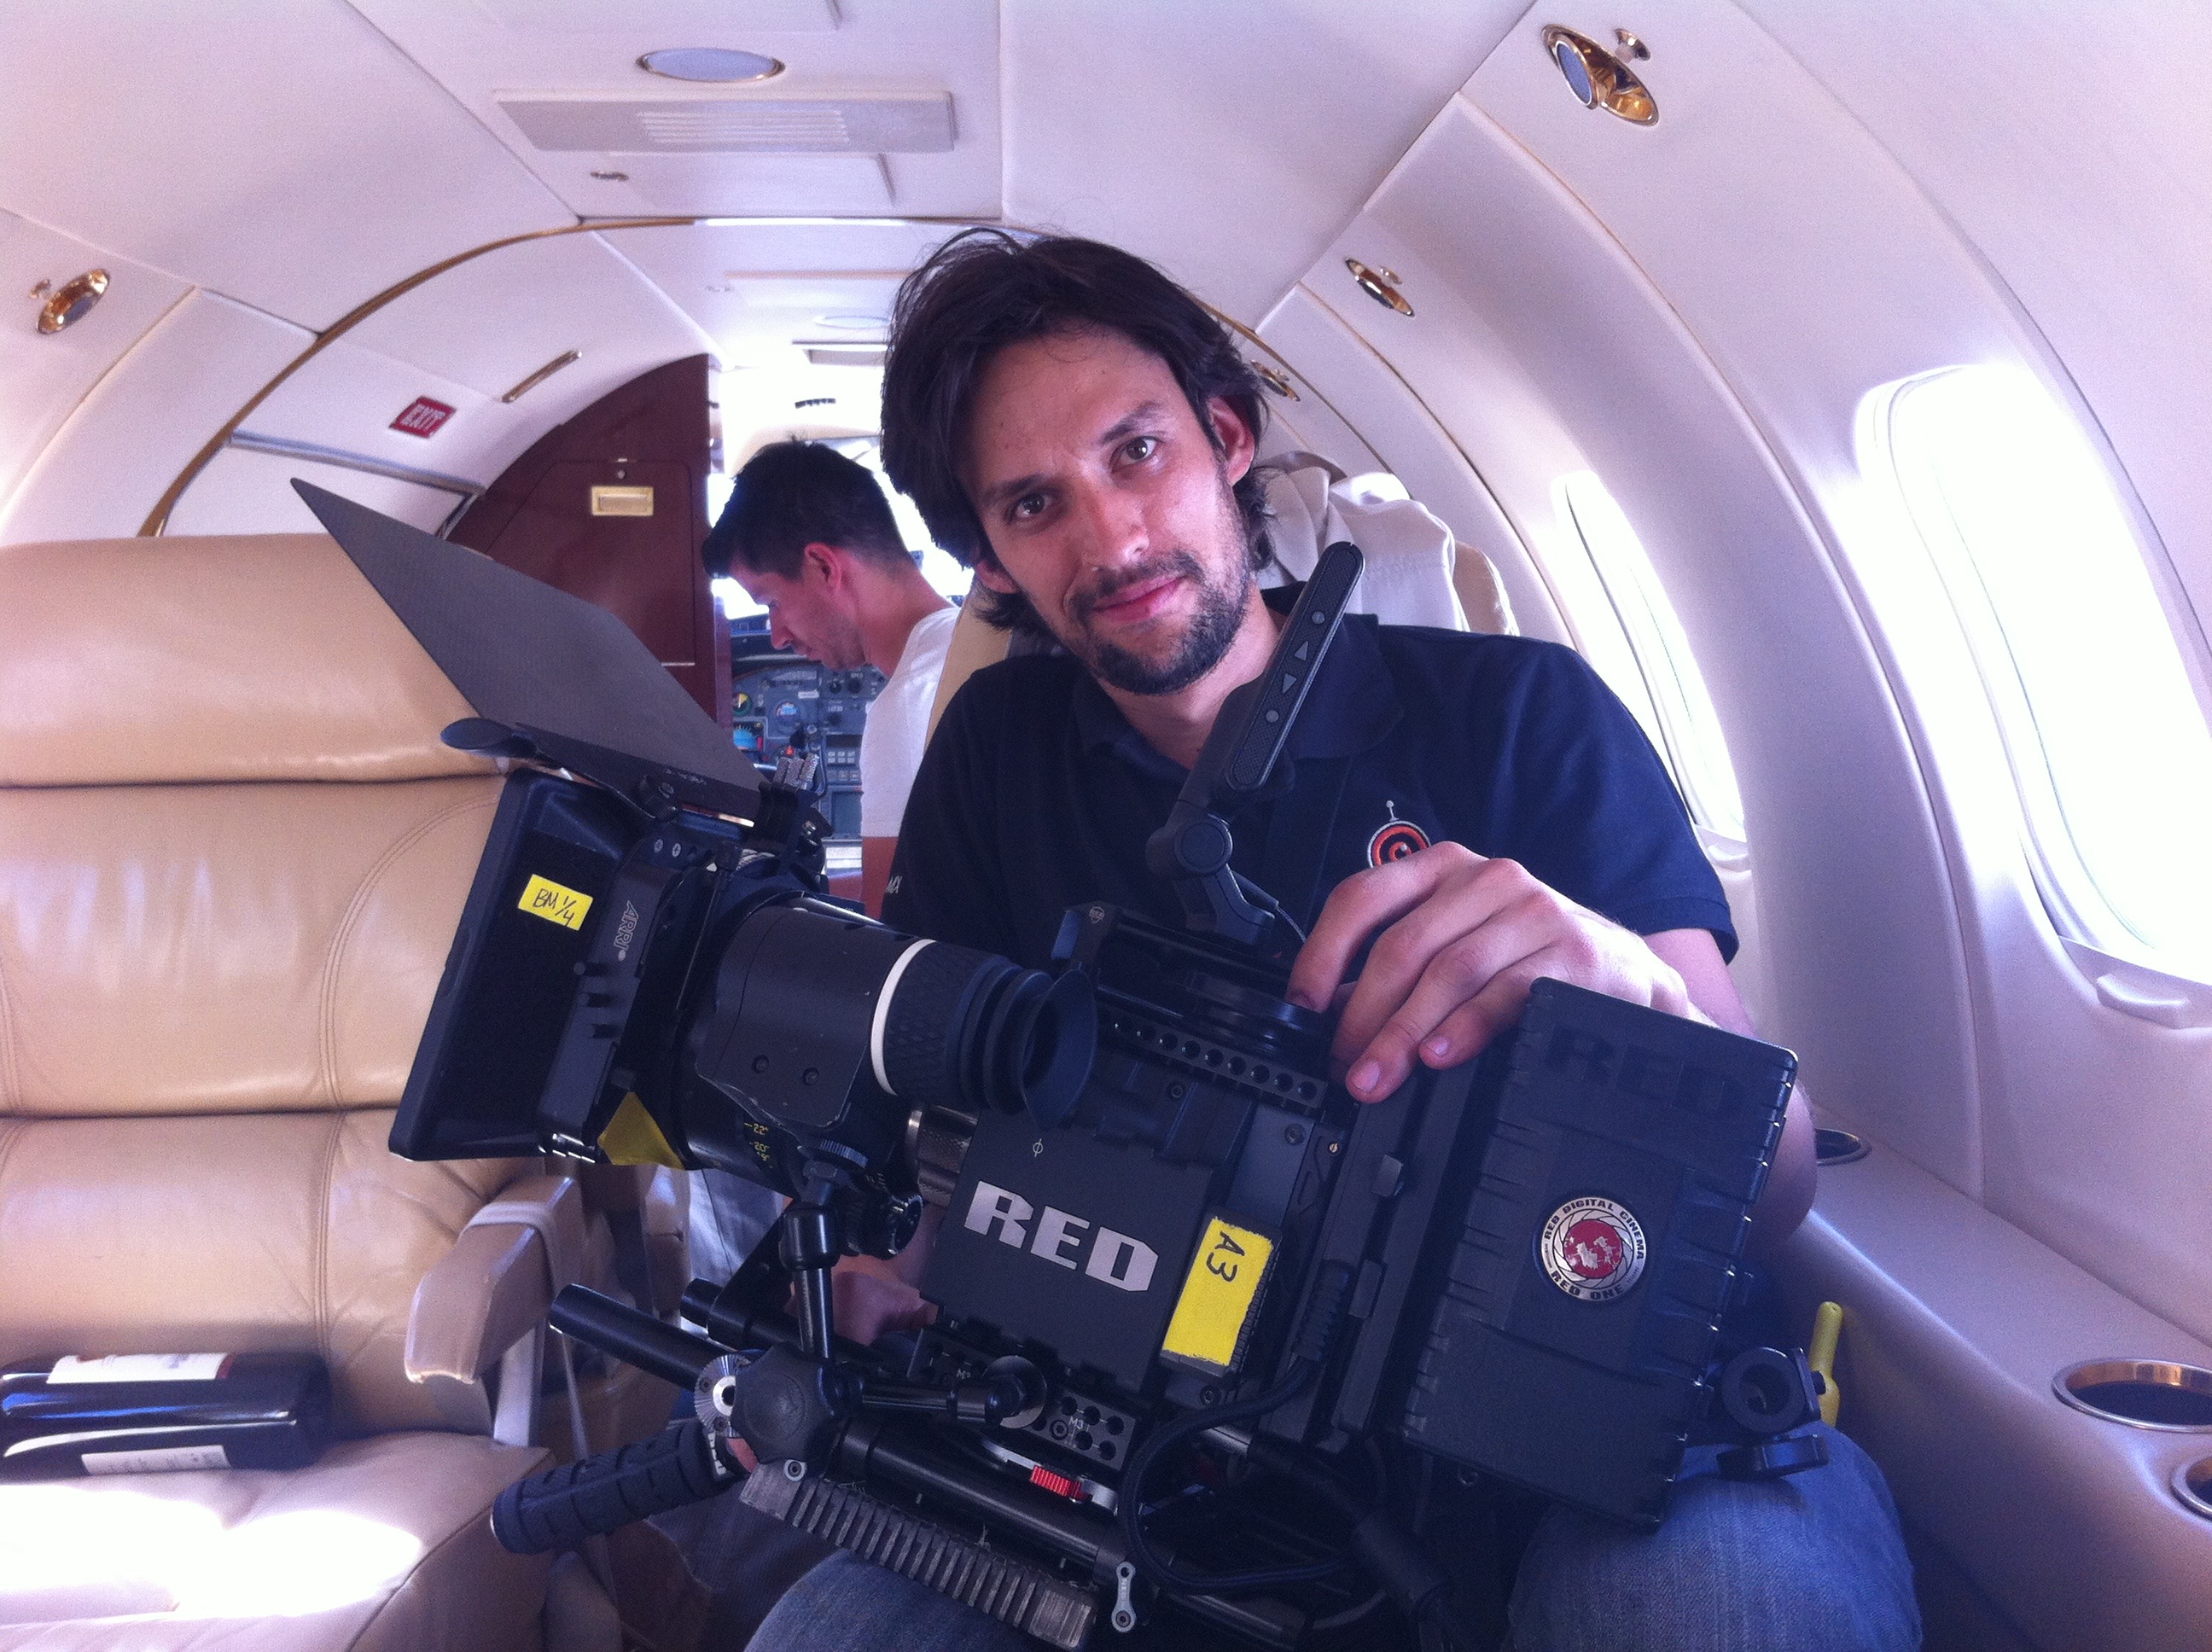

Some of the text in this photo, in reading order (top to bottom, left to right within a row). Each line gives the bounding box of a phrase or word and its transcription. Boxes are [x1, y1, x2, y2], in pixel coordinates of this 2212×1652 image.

[399, 404, 445, 431] EXIT
[533, 887, 559, 910] BM
[963, 1180, 1159, 1292] RED
[1544, 1199, 1644, 1260] RED DIGITAL CINEMA
[1206, 1230, 1246, 1283] A3
[1550, 1270, 1623, 1300] RED ONE
[1068, 1416, 1084, 1429] M3
